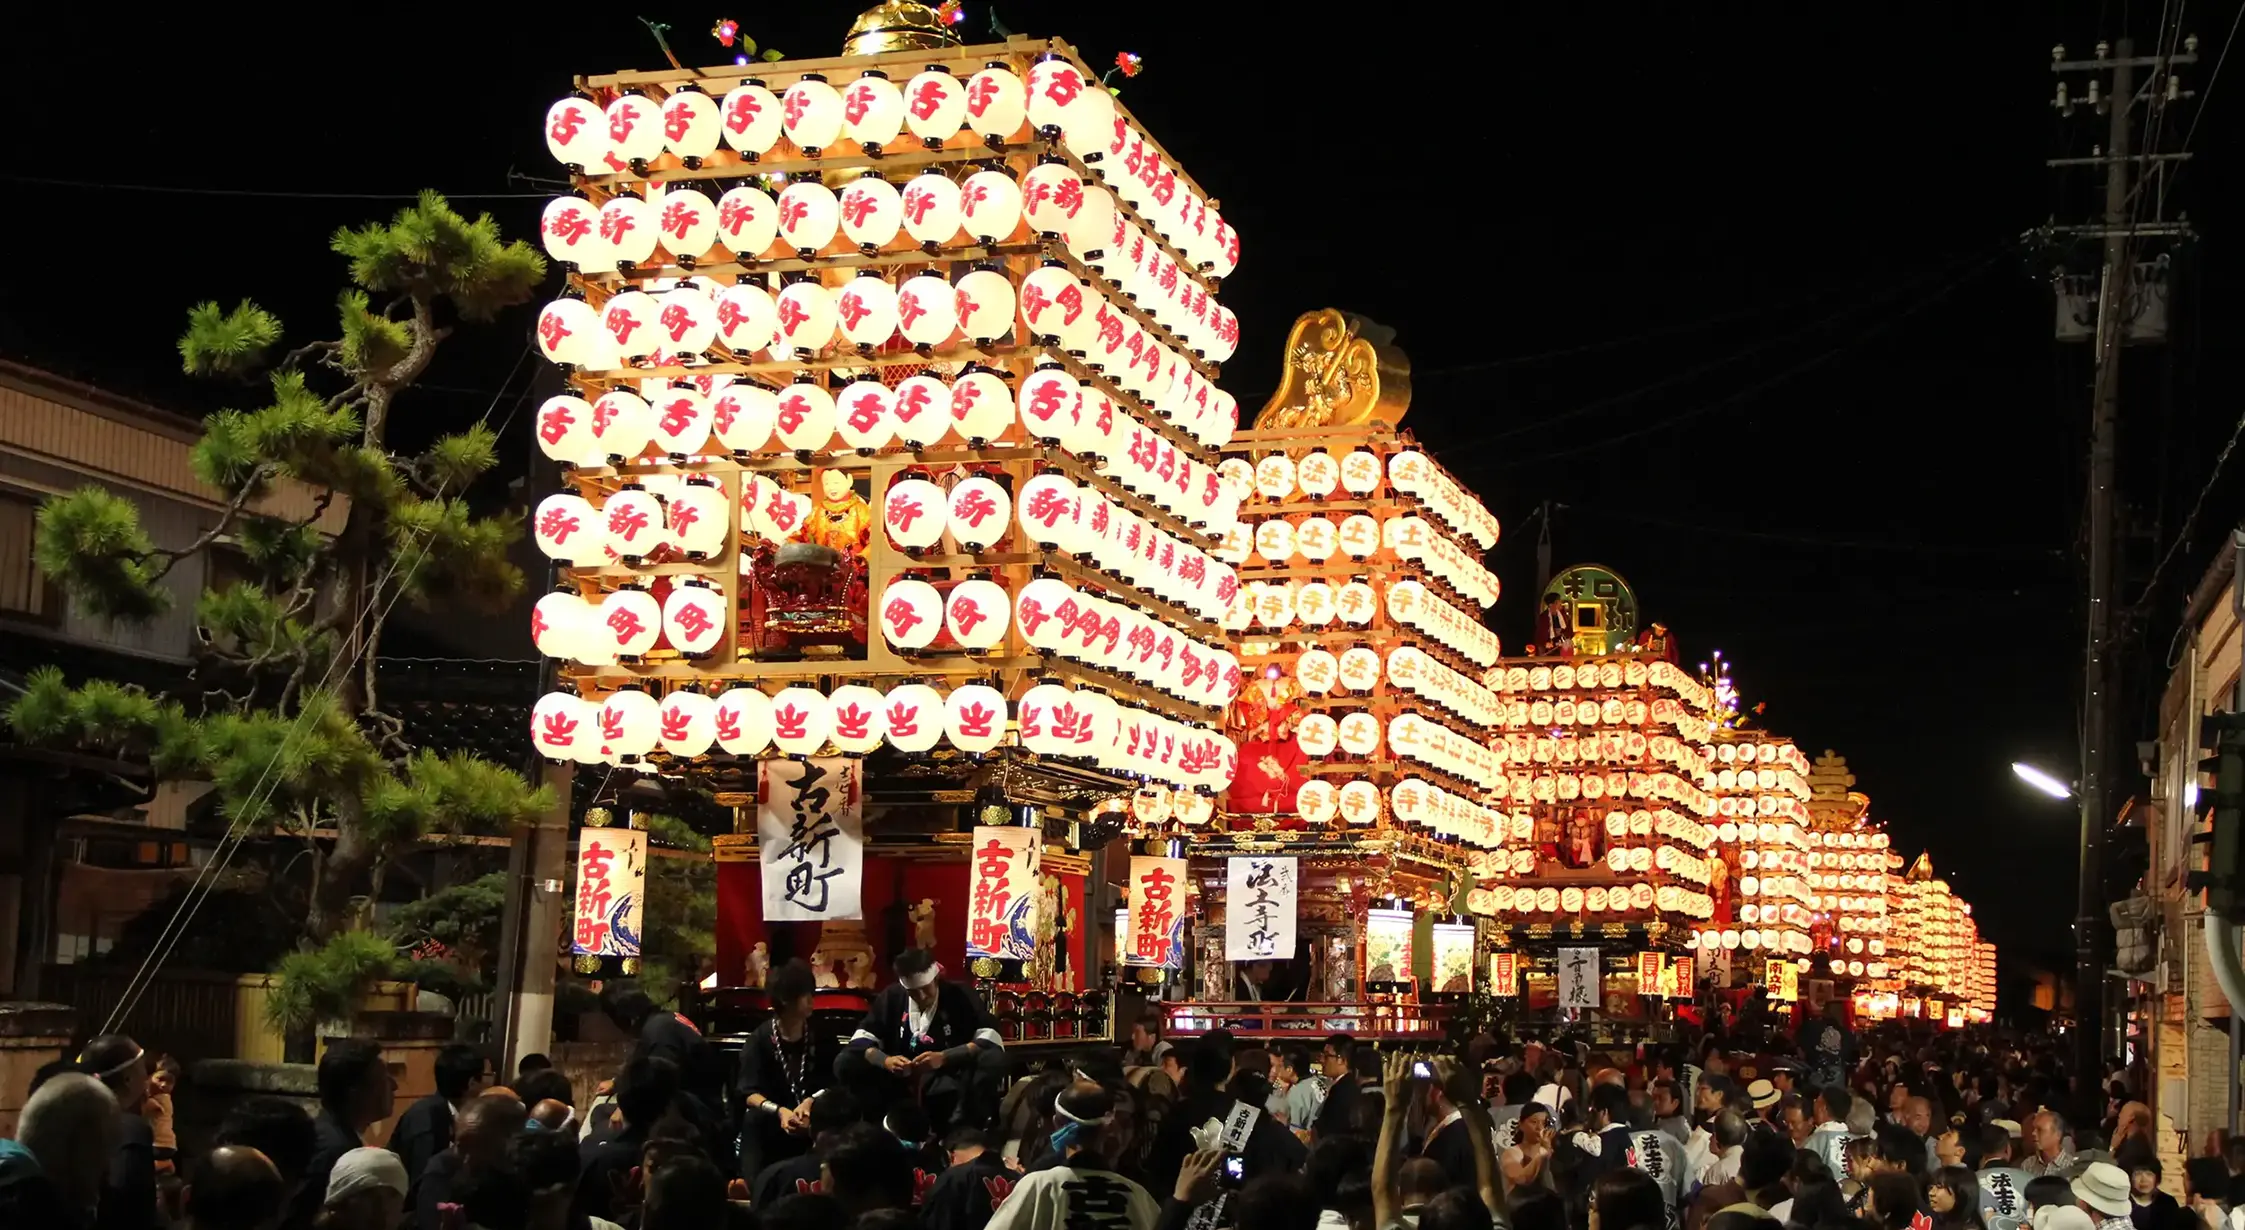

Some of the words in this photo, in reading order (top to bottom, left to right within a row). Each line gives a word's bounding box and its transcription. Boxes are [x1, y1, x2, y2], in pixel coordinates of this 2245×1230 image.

[777, 760, 845, 912] 古新町
[577, 841, 615, 952] 古新町
[972, 839, 1014, 953] 古新町
[1137, 867, 1176, 964] 古新町
[1641, 1134, 1664, 1179] 法土寺
[1991, 1173, 2016, 1214] 法土寺
